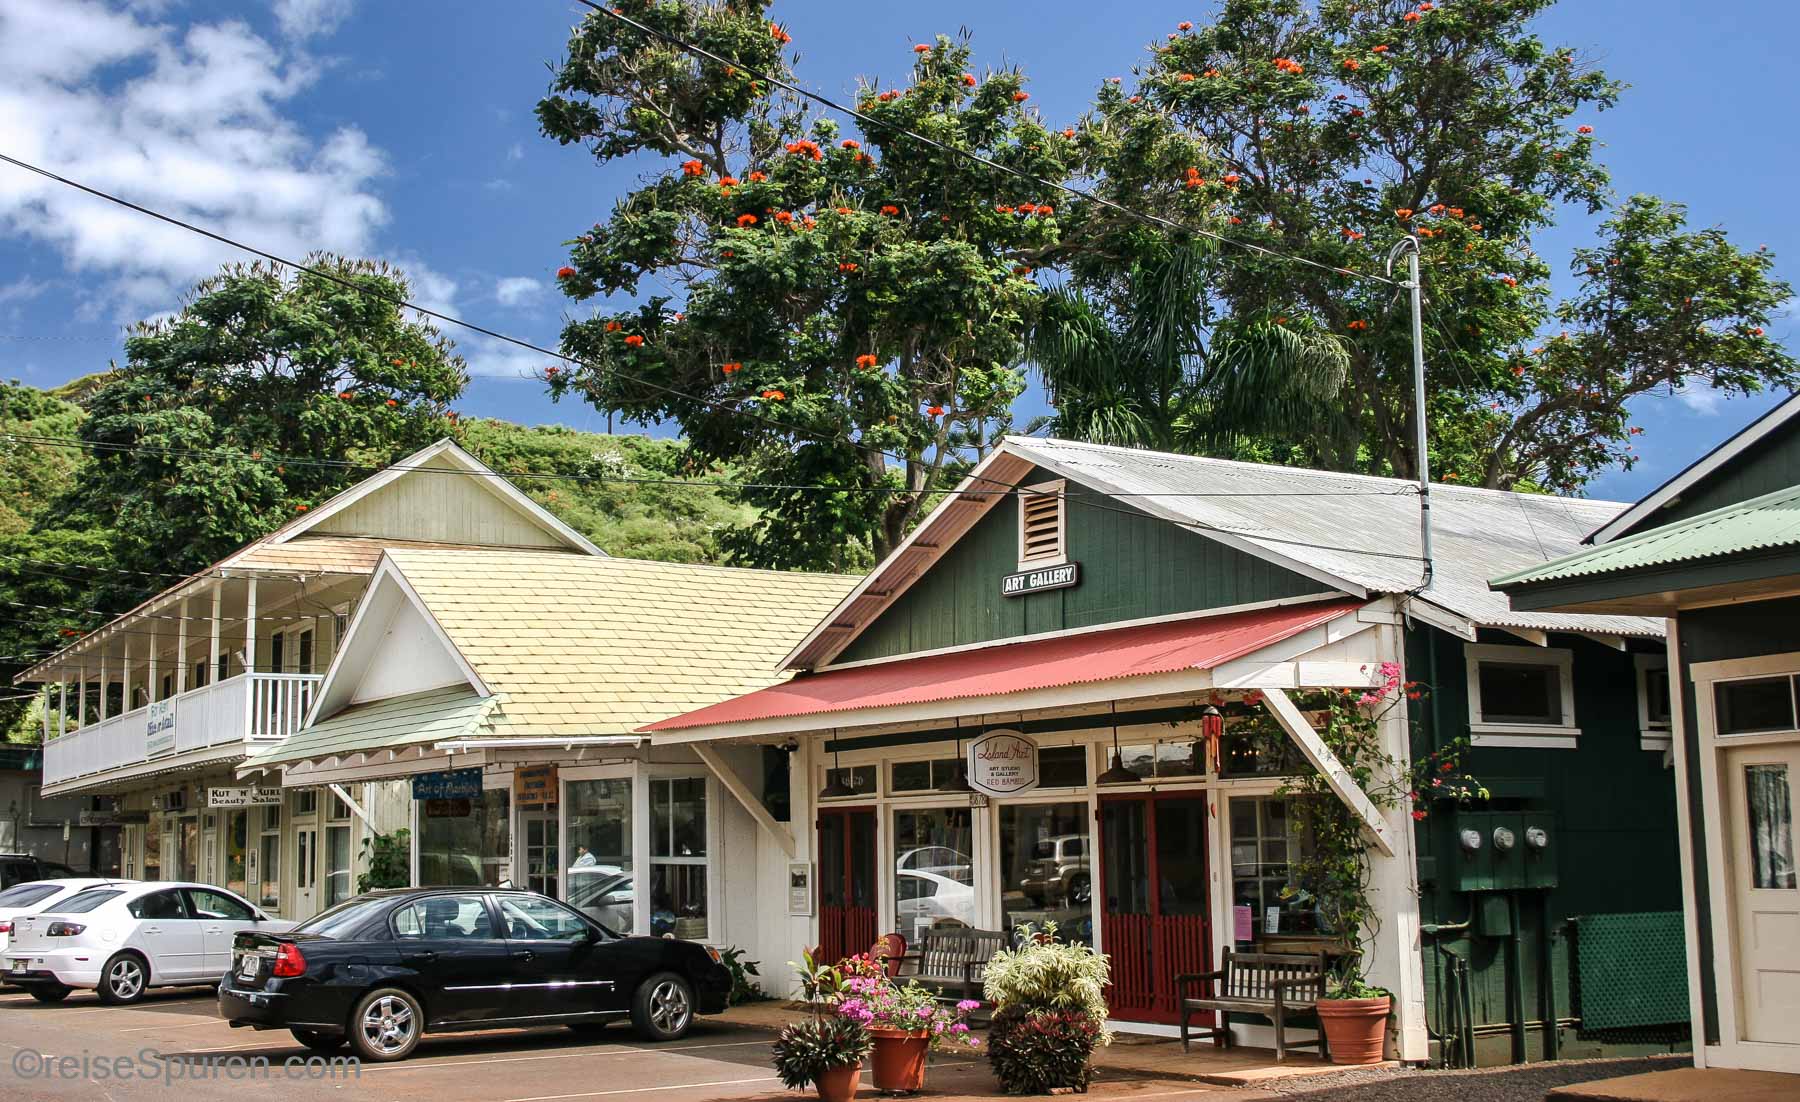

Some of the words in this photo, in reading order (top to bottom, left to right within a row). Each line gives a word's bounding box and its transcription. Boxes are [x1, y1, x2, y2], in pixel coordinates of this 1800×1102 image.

[1004, 575, 1025, 592] ART
[1029, 567, 1073, 588] GALLERY
[977, 741, 1010, 761] Island
[1010, 741, 1032, 761] Art
[212, 789, 230, 798] KUT
